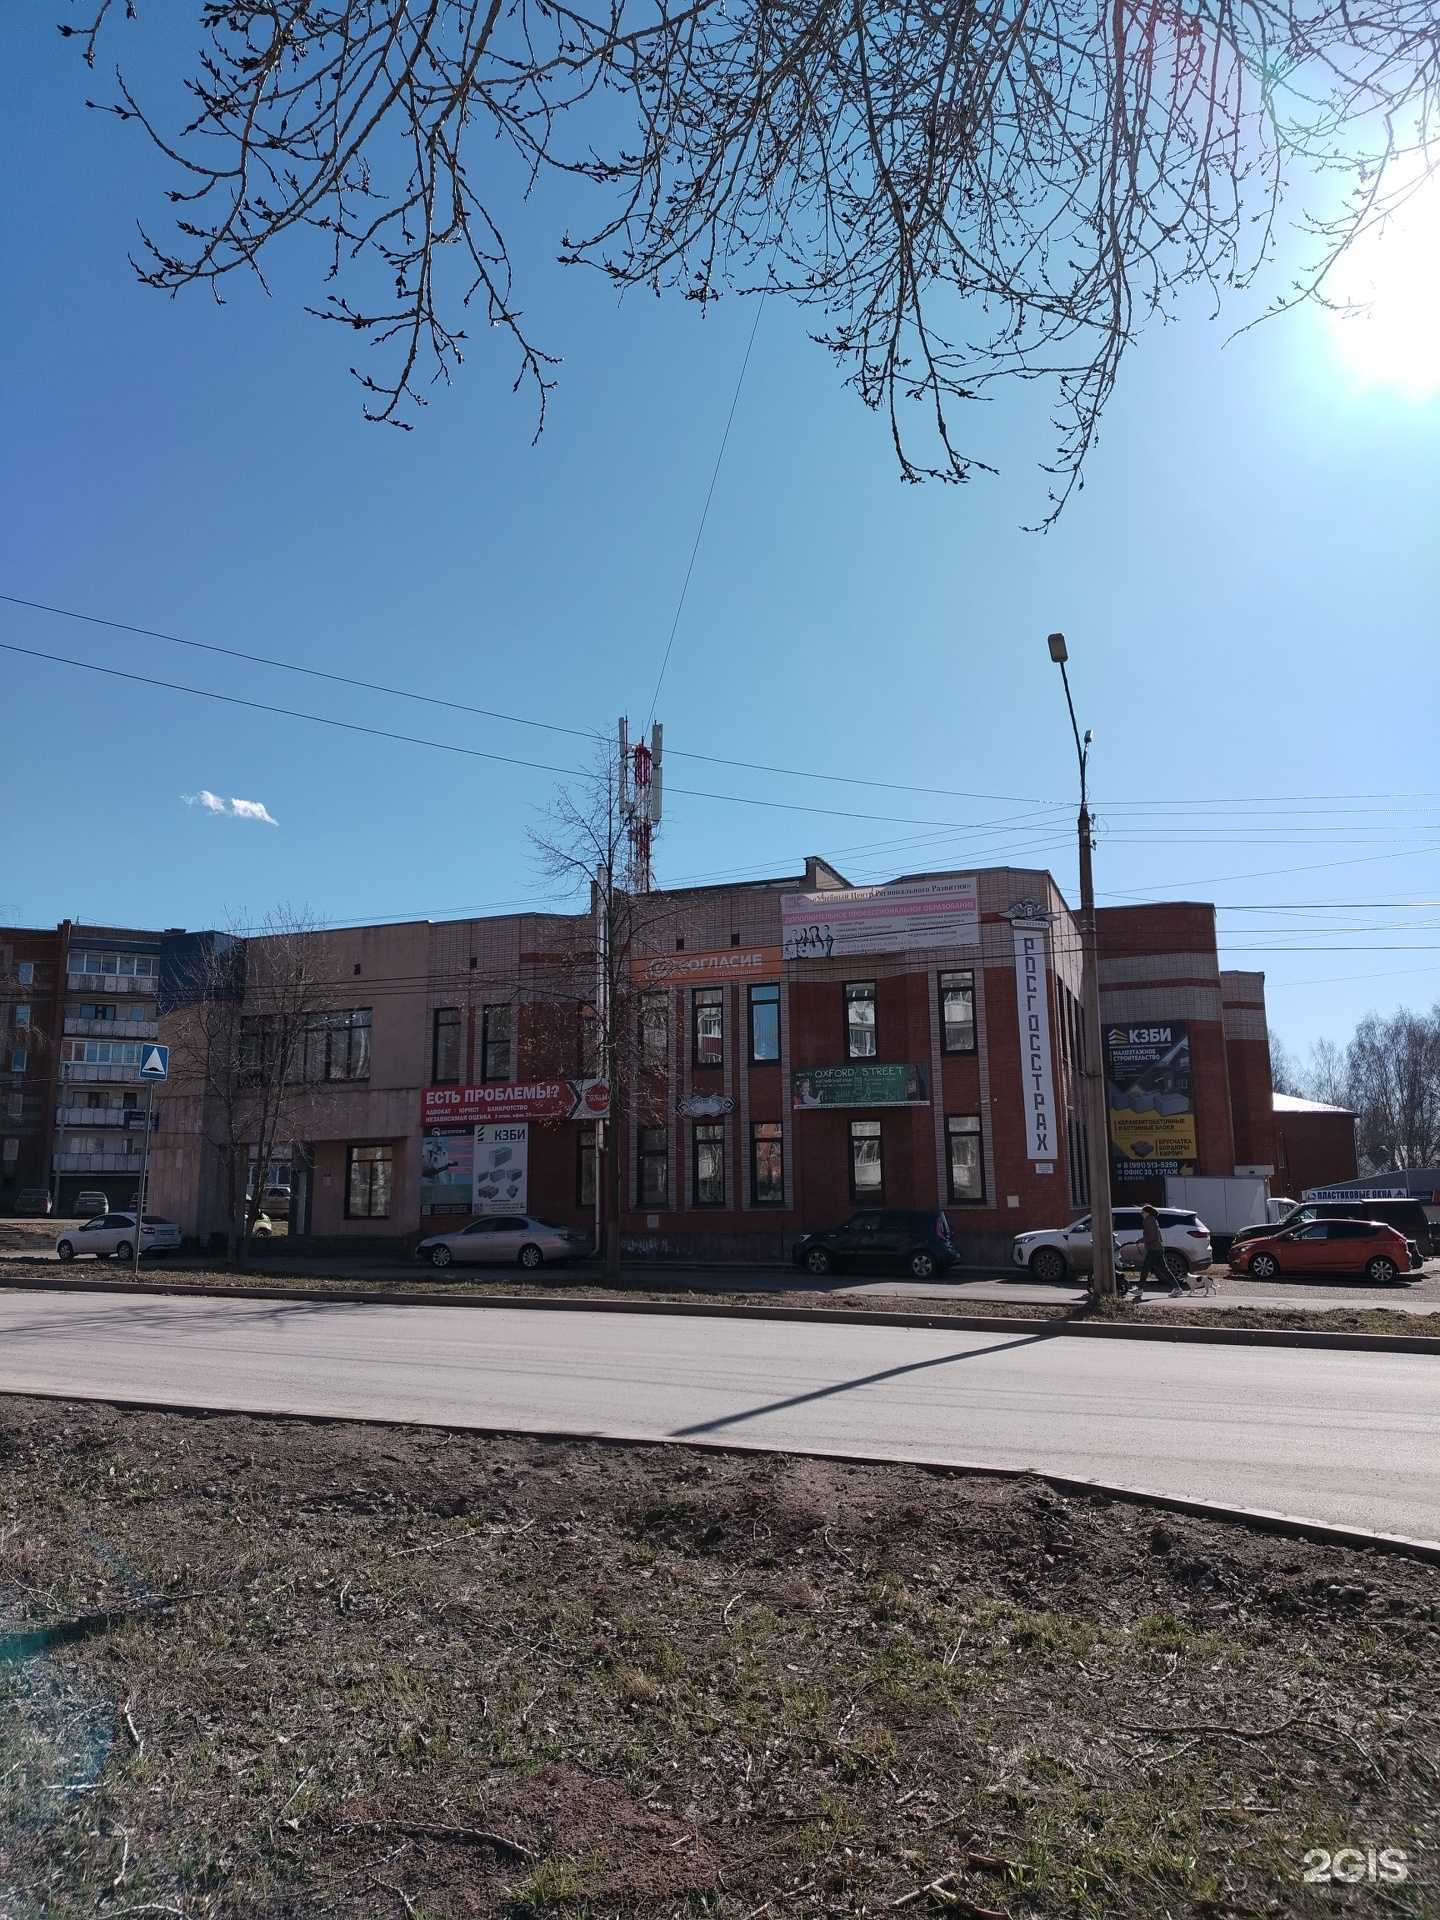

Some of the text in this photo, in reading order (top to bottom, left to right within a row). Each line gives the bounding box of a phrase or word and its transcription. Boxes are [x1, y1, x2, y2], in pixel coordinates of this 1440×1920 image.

[1129, 1028, 1172, 1043] КЗБИ
[1024, 938, 1049, 1151] РОСГОССТРАХ
[815, 1066, 904, 1078] OXFORD STREET
[426, 1085, 560, 1105] ЕСТЬ ПРОБЛЕМЫ?
[458, 1106, 479, 1114] ЮРИСТ
[425, 1114, 468, 1122] НЕЗАВИСИМАЯ
[469, 1113, 491, 1121] ОЦЕНКА
[494, 1129, 525, 1140] КЗБИ
[1318, 1190, 1392, 1200] ПЛАСТИКОВЫЕ ОКНА
